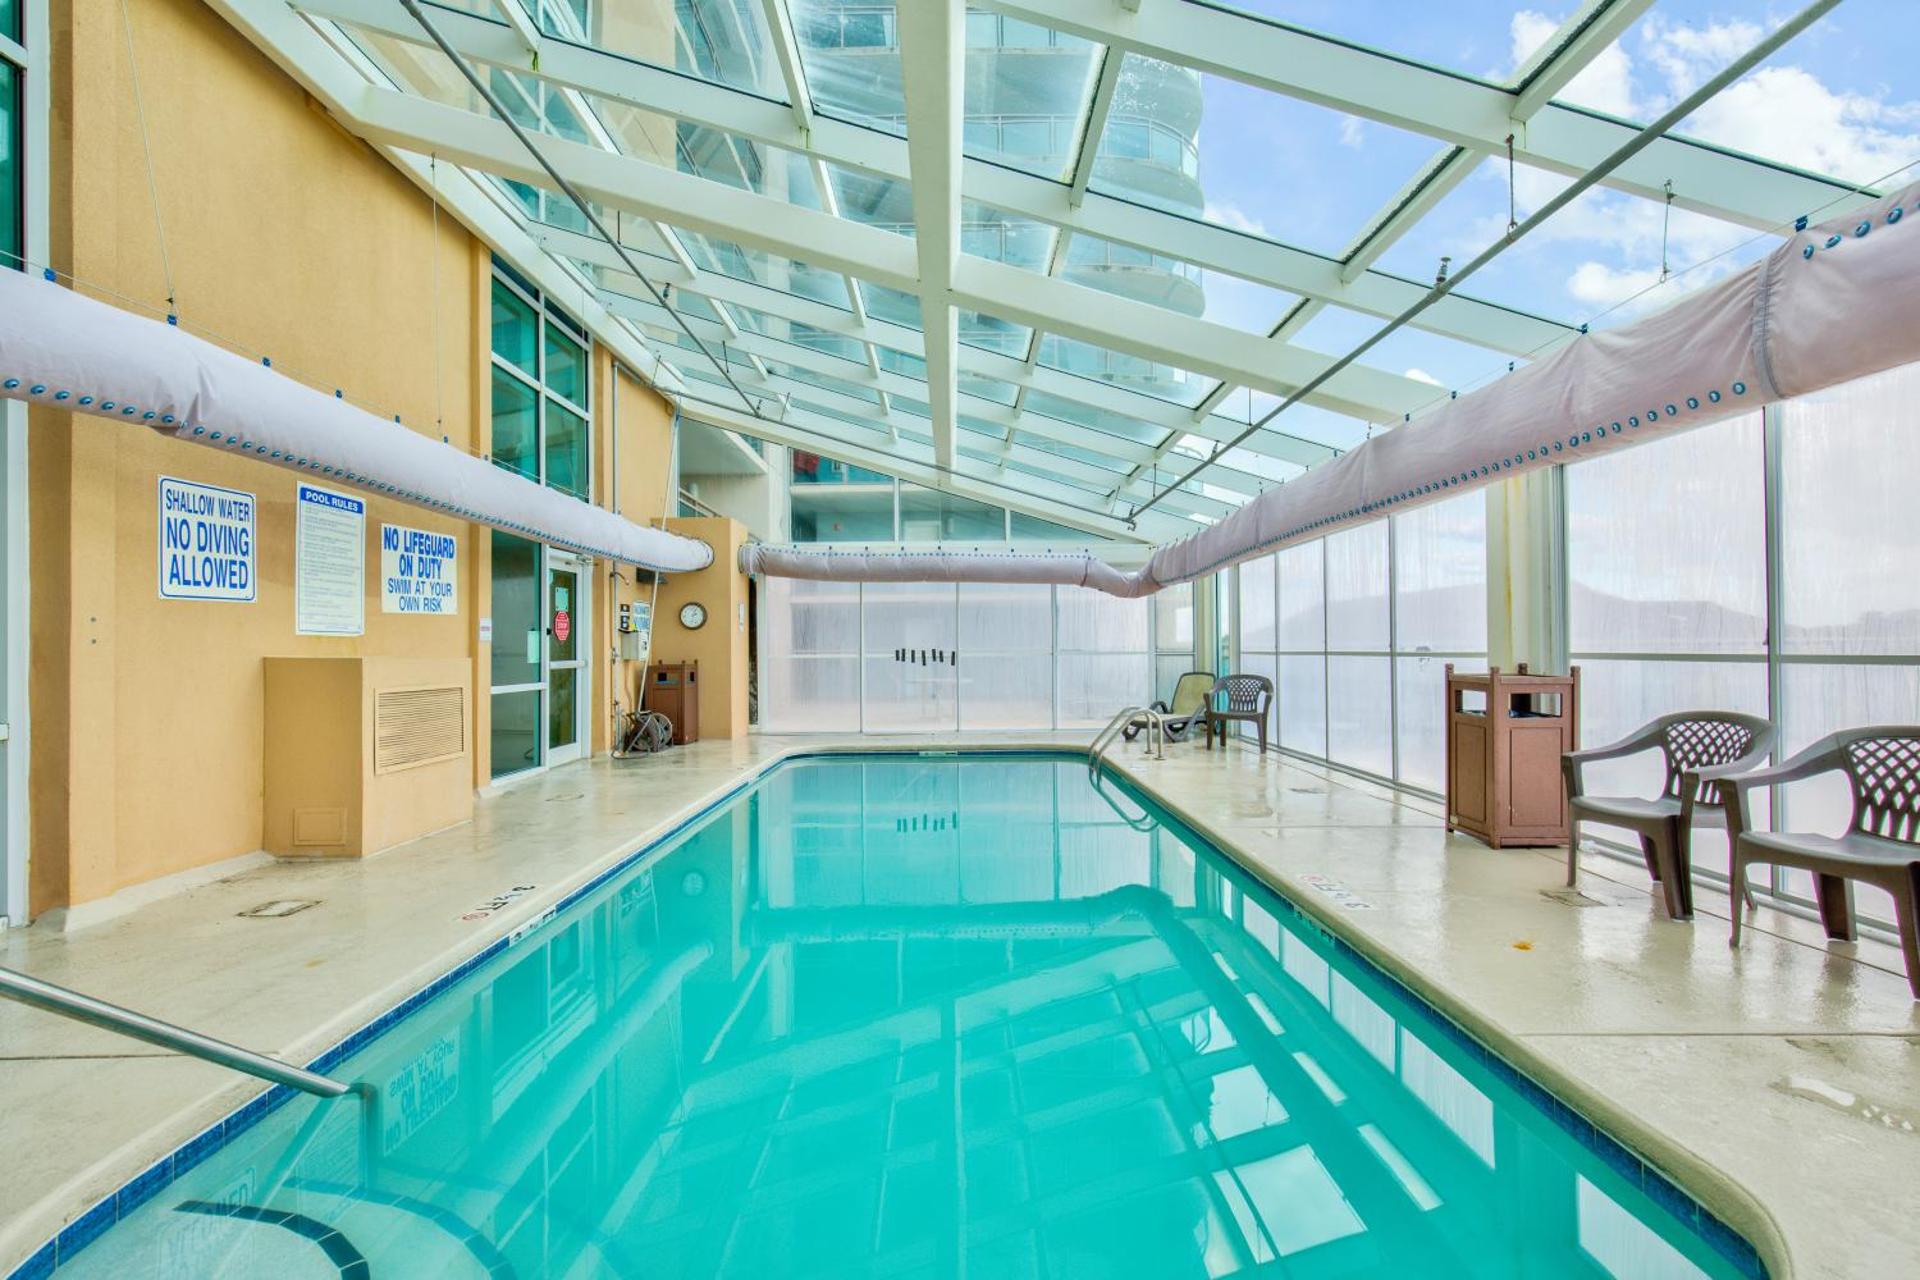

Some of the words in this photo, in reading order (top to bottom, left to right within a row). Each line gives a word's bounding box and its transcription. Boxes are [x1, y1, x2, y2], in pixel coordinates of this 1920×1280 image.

[166, 488, 214, 517] SHALLOW
[218, 498, 250, 522] WATER
[305, 491, 330, 505] POOL
[332, 497, 358, 512] RULES
[166, 517, 191, 550] NO
[197, 521, 249, 557] DIVING
[384, 527, 399, 551] NO
[404, 530, 455, 559] LIFEGUARD
[169, 554, 248, 590] ALLOWED
[399, 554, 413, 577] ON
[418, 556, 442, 579] DUTY
[388, 578, 411, 595] SWIM
[415, 581, 426, 595] AT
[430, 582, 453, 597] YOUR
[400, 596, 420, 611] OWN
[423, 597, 442, 612] RISK
